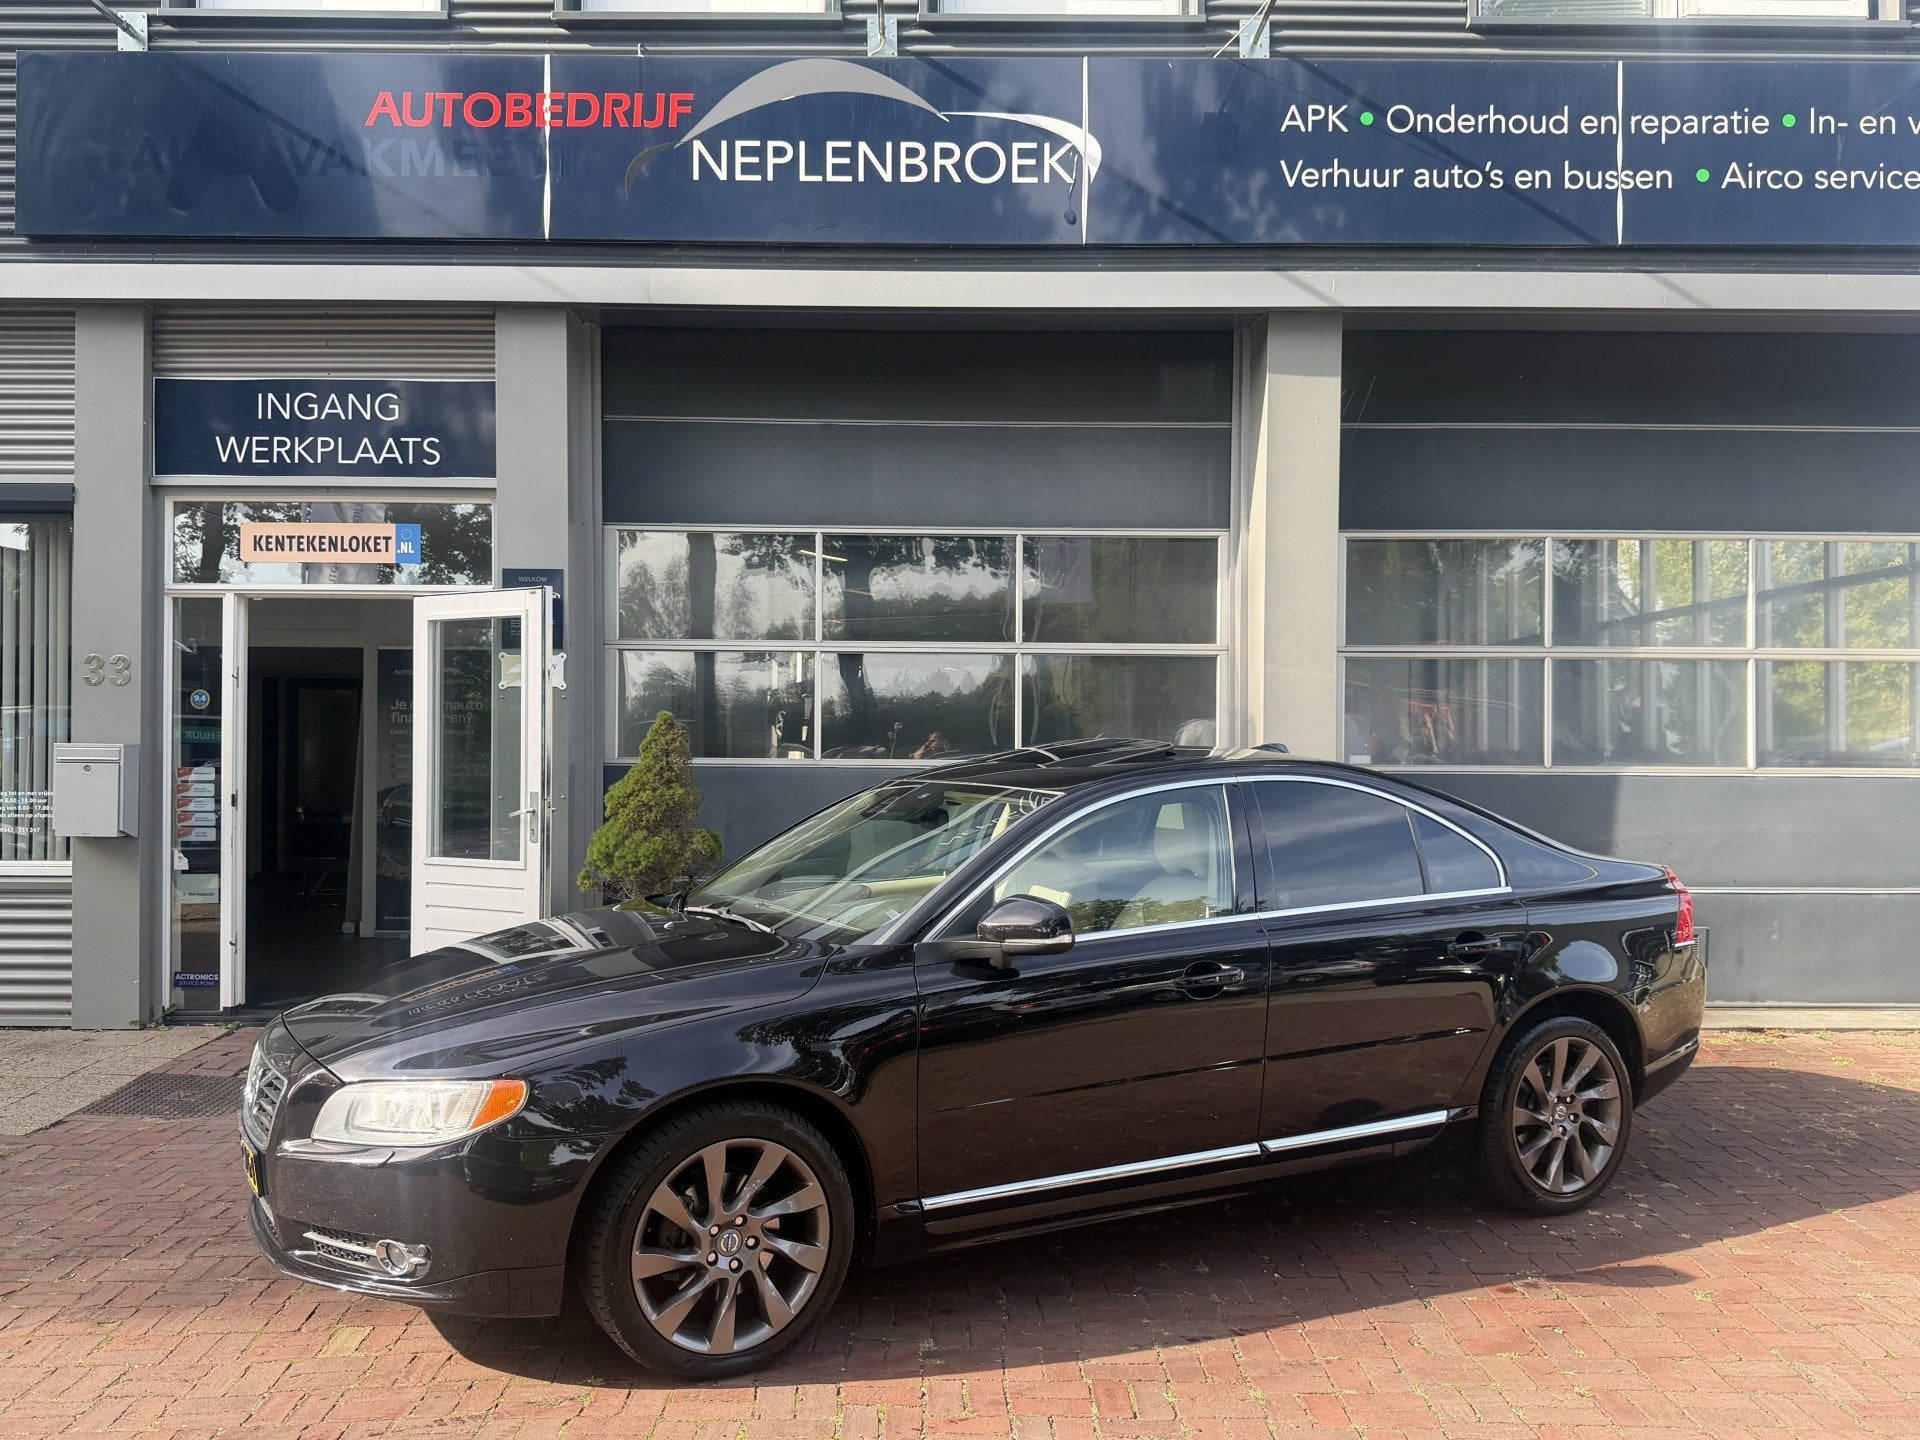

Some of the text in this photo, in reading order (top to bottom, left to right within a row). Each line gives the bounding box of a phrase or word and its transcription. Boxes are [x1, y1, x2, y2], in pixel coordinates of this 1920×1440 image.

[367, 91, 695, 129] AUTOBEDRIJF
[1280, 104, 1349, 133] APK
[1386, 103, 1569, 135] Onderhoud
[1580, 115, 1617, 135] en
[1629, 107, 1770, 145] reparatie
[1810, 107, 1849, 135] In-
[1859, 115, 1896, 135] en
[692, 140, 1075, 185] NEPLENBROEK
[1279, 158, 1405, 189] Verhuur
[1514, 169, 1552, 190] en
[1564, 160, 1673, 190] bussen
[1720, 161, 1803, 190] Airco
[1814, 162, 1920, 190] service
[257, 392, 400, 421] INGANG
[215, 436, 441, 466] WERKPLAATS
[253, 534, 392, 553] KENTEKENLOKET
[82, 653, 132, 687] 33
[390, 699, 407, 710] Je
[175, 973, 219, 981] ACTRONICS
